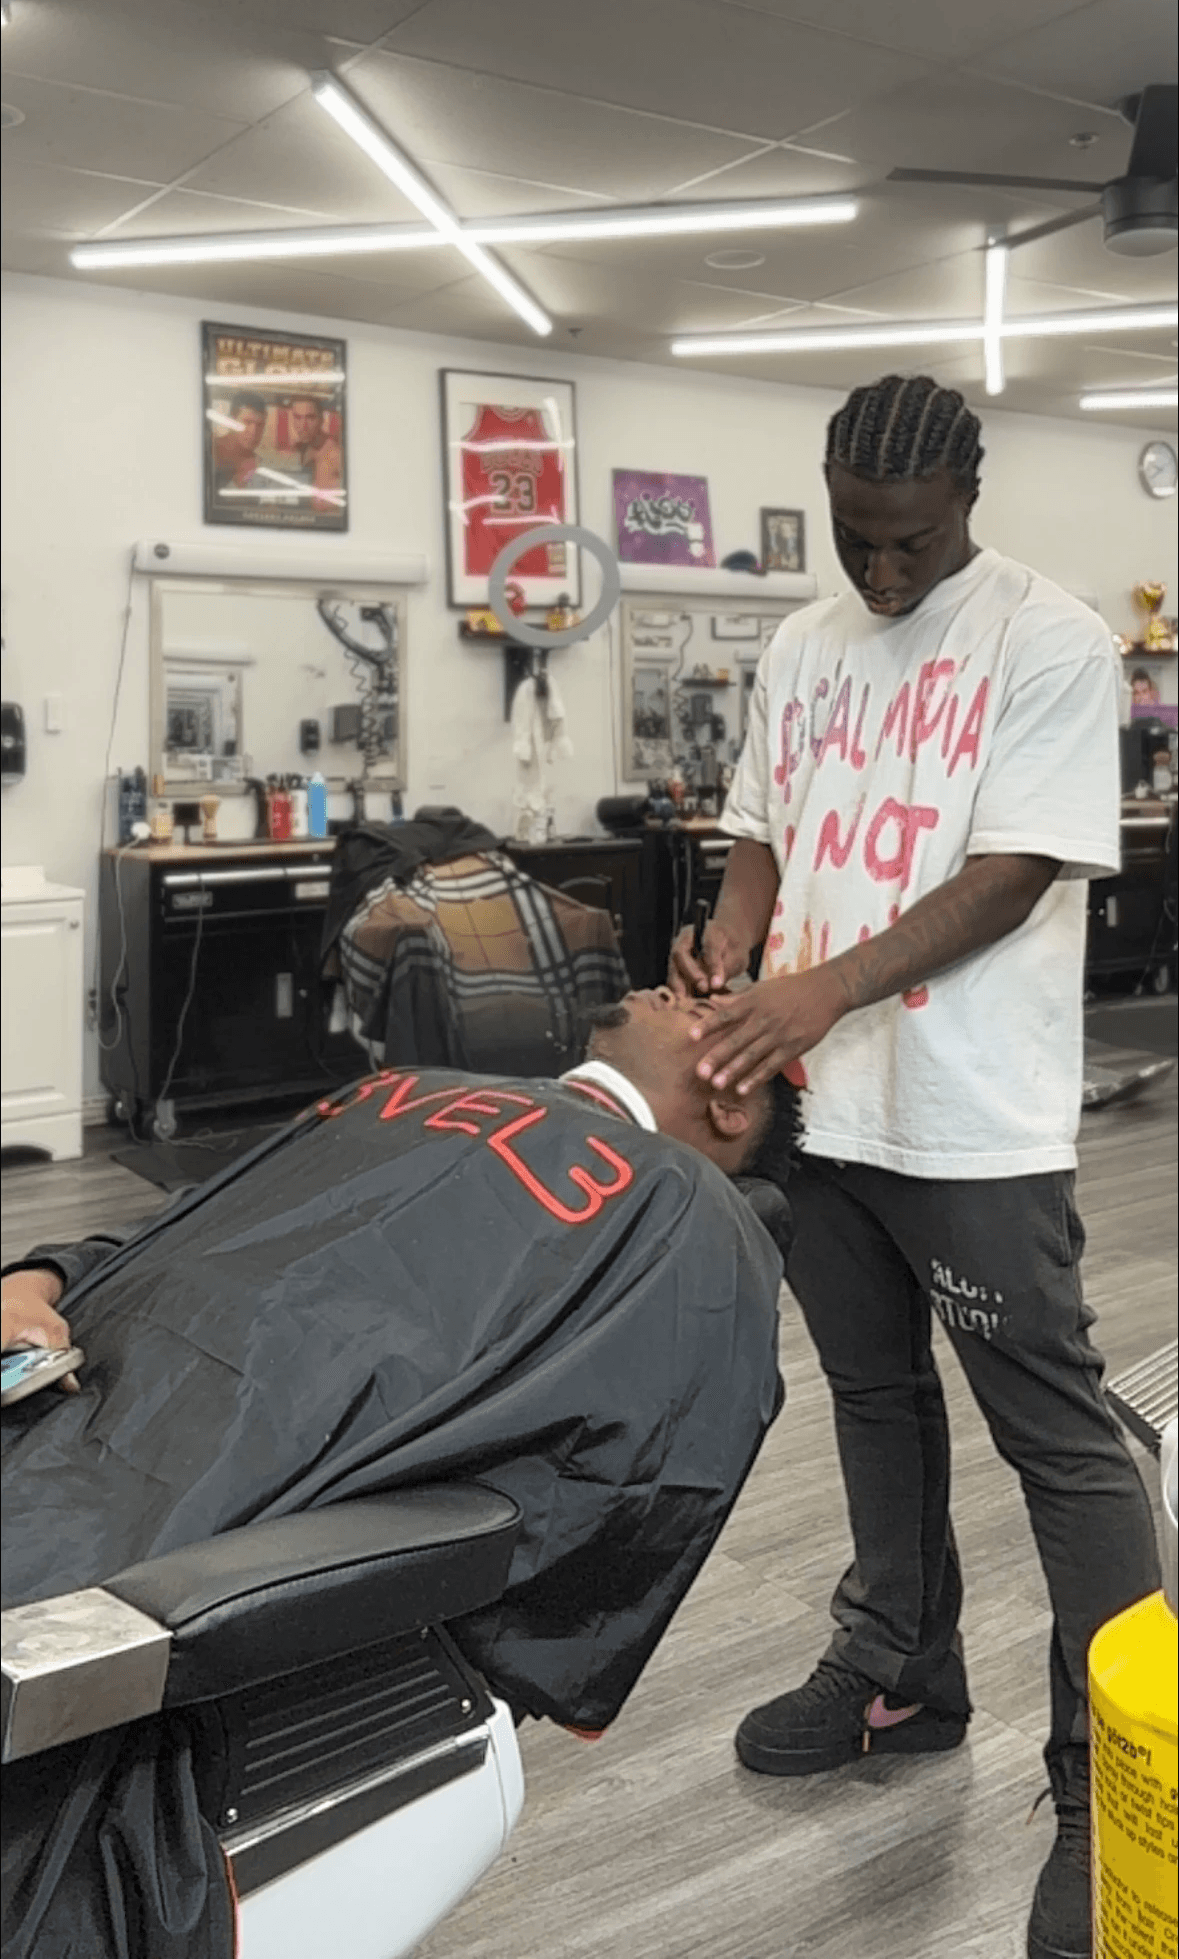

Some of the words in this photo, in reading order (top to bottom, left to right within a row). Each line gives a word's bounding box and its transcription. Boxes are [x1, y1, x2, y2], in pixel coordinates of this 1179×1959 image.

[217, 338, 335, 367] ULTIMATE
[490, 470, 537, 514] 23
[813, 794, 940, 890] NOT
